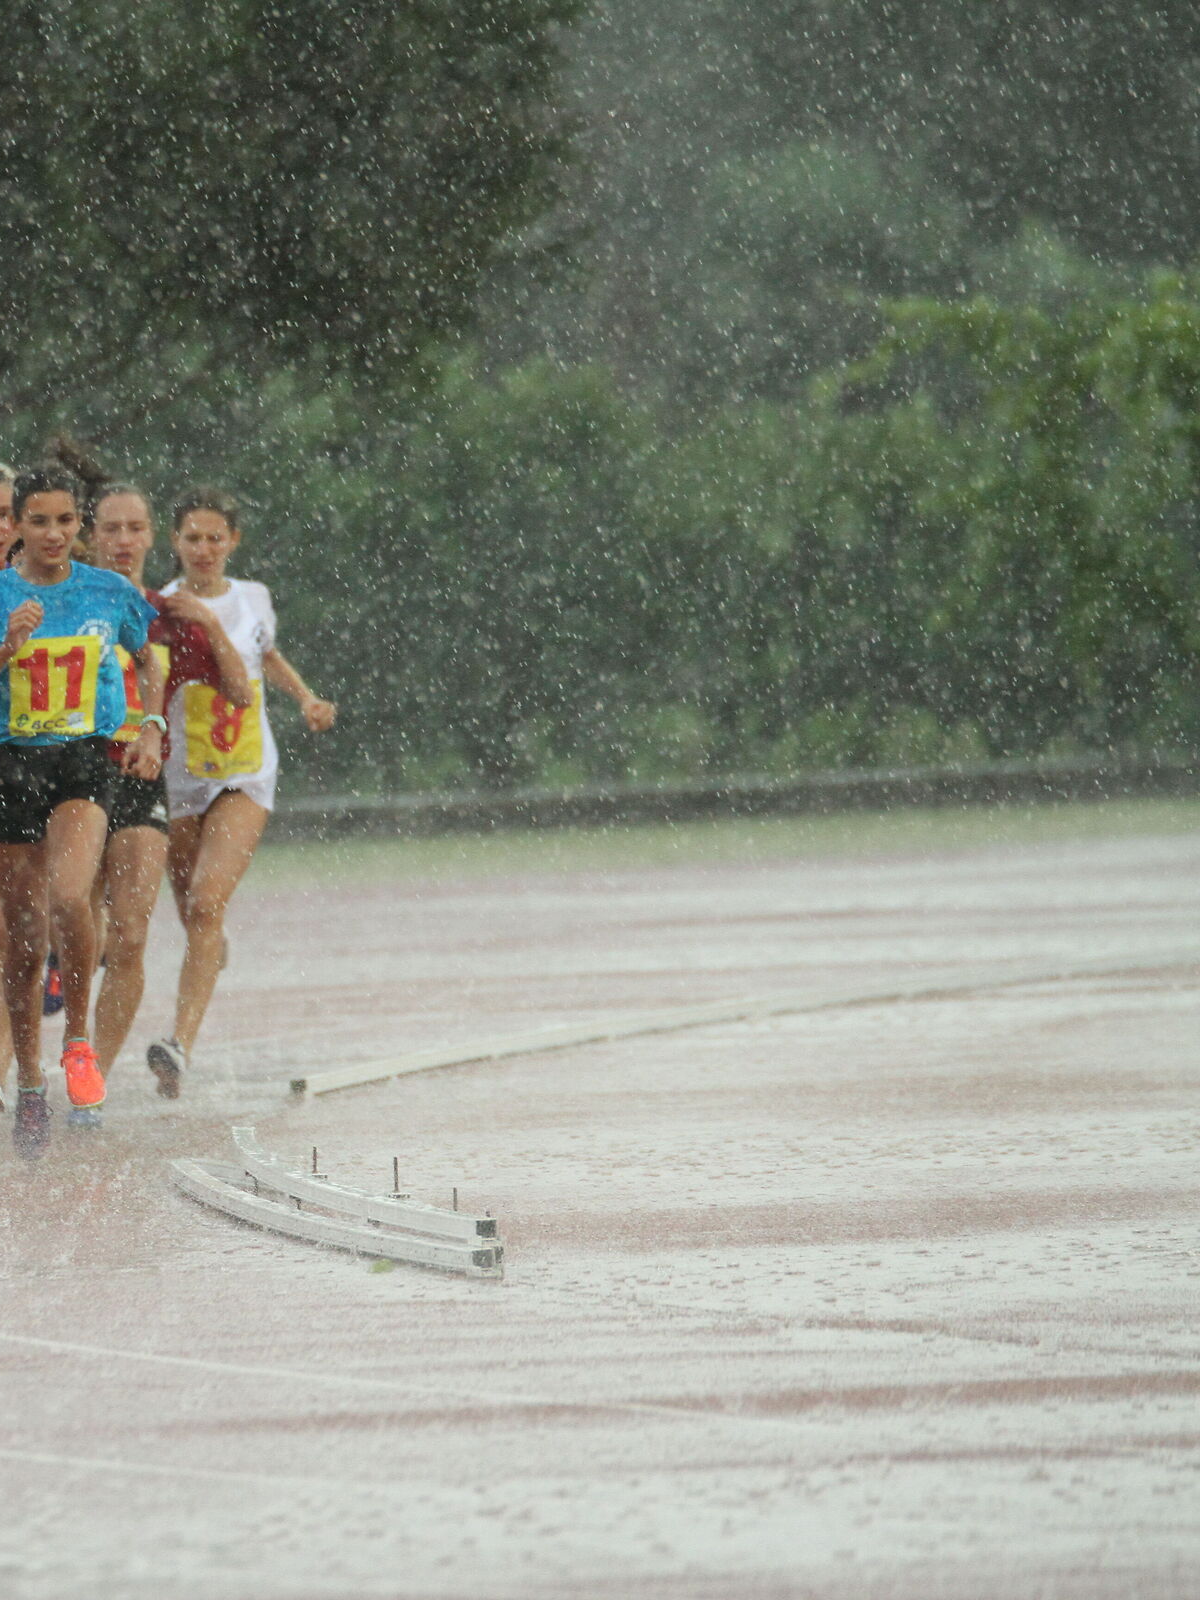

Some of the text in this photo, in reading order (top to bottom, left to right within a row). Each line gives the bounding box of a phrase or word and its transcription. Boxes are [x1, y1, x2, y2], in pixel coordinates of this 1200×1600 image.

[17, 645, 85, 711] 11
[32, 718, 67, 730] BCC
[211, 692, 245, 753] 8
